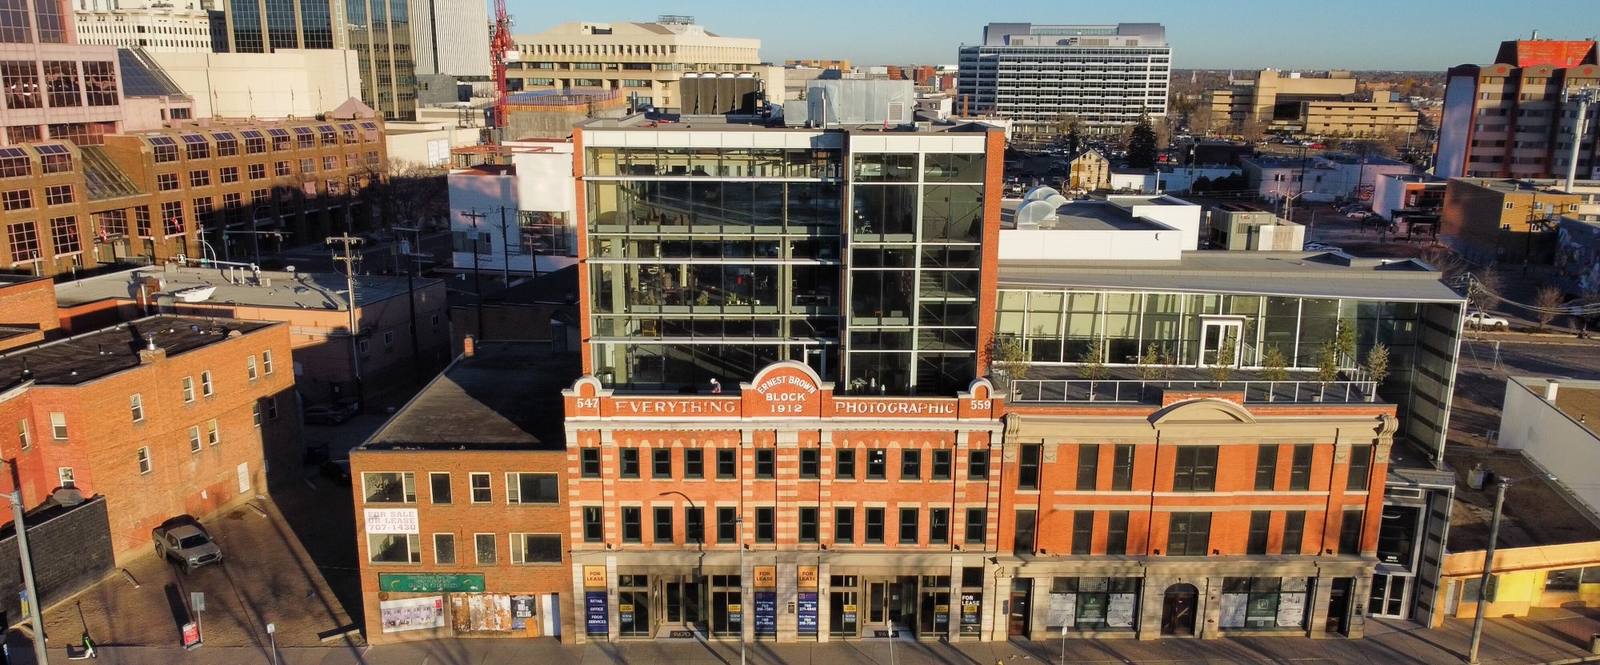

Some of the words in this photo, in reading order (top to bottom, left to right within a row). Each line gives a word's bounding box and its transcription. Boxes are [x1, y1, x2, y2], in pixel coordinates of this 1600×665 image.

[757, 375, 786, 394] ERNEST
[788, 375, 817, 394] BROWN
[766, 393, 805, 401] BLOCK
[577, 399, 599, 408] 547
[616, 401, 736, 413] EVERYTHING
[771, 404, 802, 413] 1912
[835, 401, 954, 414] PHOTOGRAPHIC
[970, 400, 991, 410] 559
